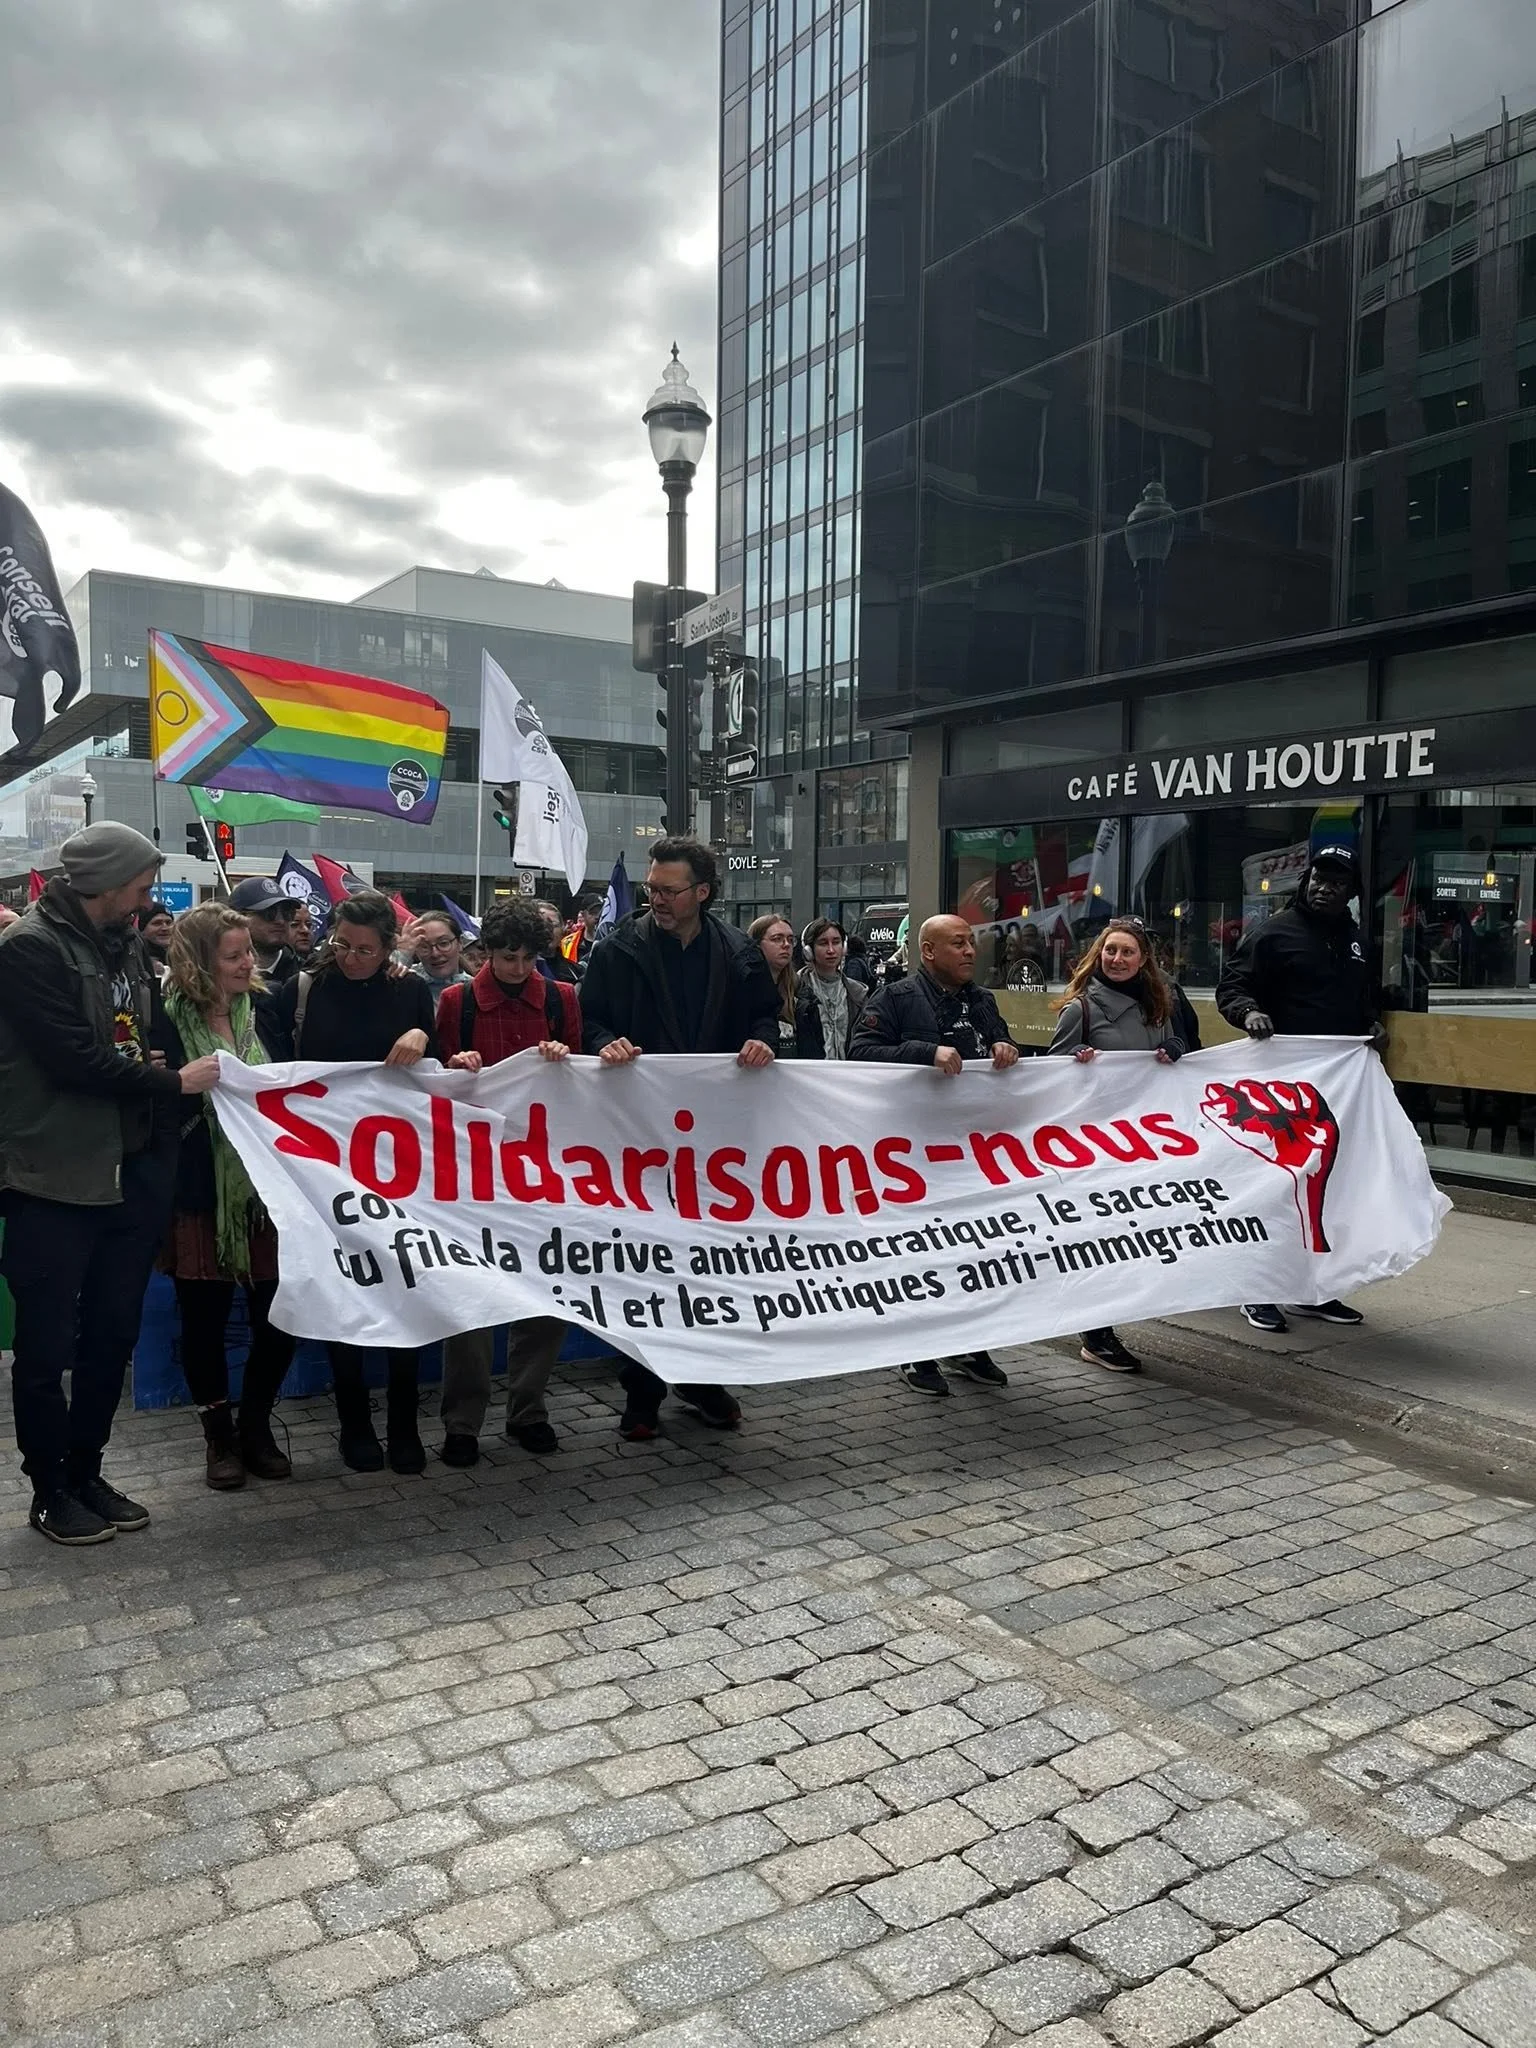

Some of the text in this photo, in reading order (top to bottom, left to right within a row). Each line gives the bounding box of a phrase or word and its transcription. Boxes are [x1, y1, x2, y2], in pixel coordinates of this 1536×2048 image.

[690, 607, 731, 640] Saint-Joseph
[1066, 728, 1436, 801] CAFÉ VAN HOUTTE
[728, 855, 758, 871] DOYLE
[1436, 887, 1501, 899] SORTIE ENTRÉE
[870, 927, 895, 941] àVélo
[1007, 983, 1019, 992] VAN
[256, 1080, 1199, 1222] Solidarisons-nous
[481, 1227, 523, 1273] la
[538, 1226, 676, 1275] derive
[689, 1213, 1036, 1275] antidémocratique,
[1036, 1193, 1082, 1226] le
[1088, 1178, 1230, 1215] saccage
[622, 1291, 666, 1328] et
[677, 1283, 741, 1328] les
[752, 1268, 947, 1332] politiques
[956, 1215, 1270, 1293] anti-immigration
